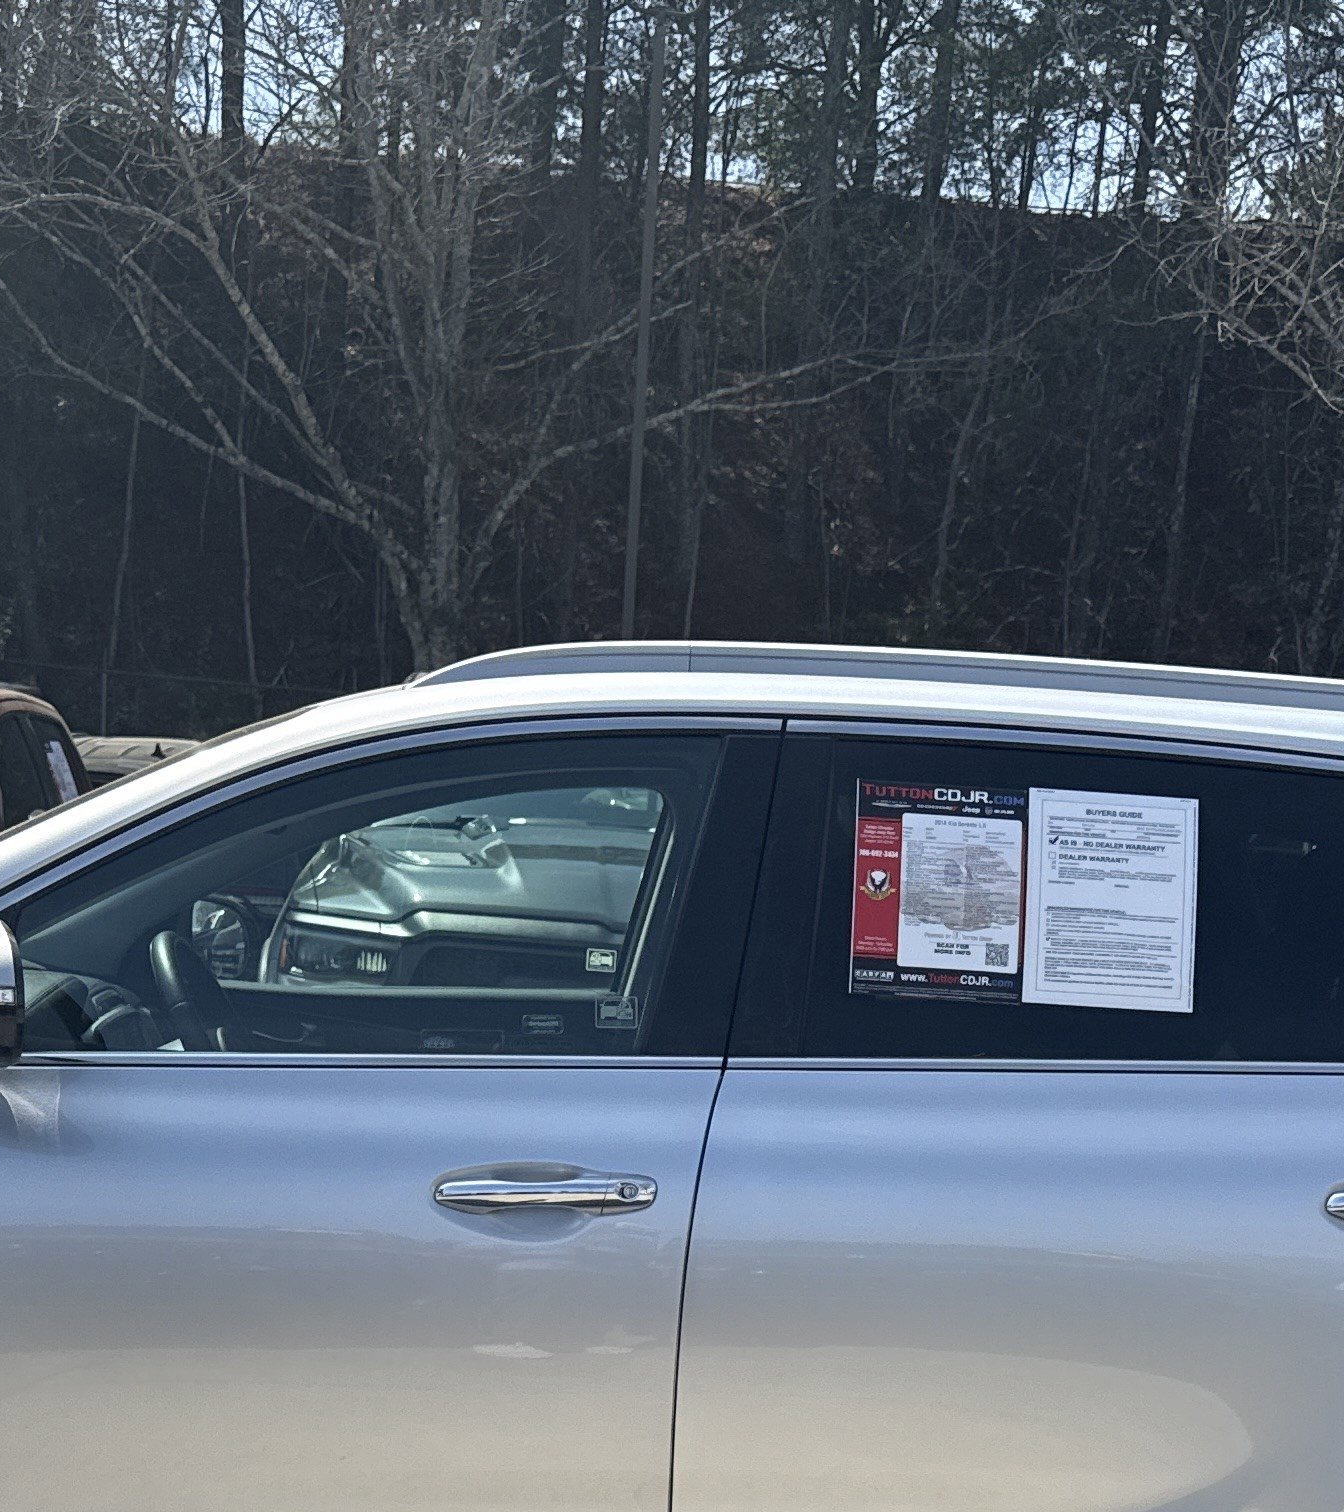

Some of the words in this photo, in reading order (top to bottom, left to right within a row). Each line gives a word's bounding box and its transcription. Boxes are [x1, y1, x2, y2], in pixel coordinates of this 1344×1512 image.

[1086, 808, 1117, 818] BUYERS
[1119, 810, 1143, 819] GUIDE
[1096, 841, 1123, 850] DEALER
[1125, 843, 1165, 852] WARRANTY
[1058, 853, 1087, 861] DEALER
[1089, 854, 1130, 864] WARRANTY
